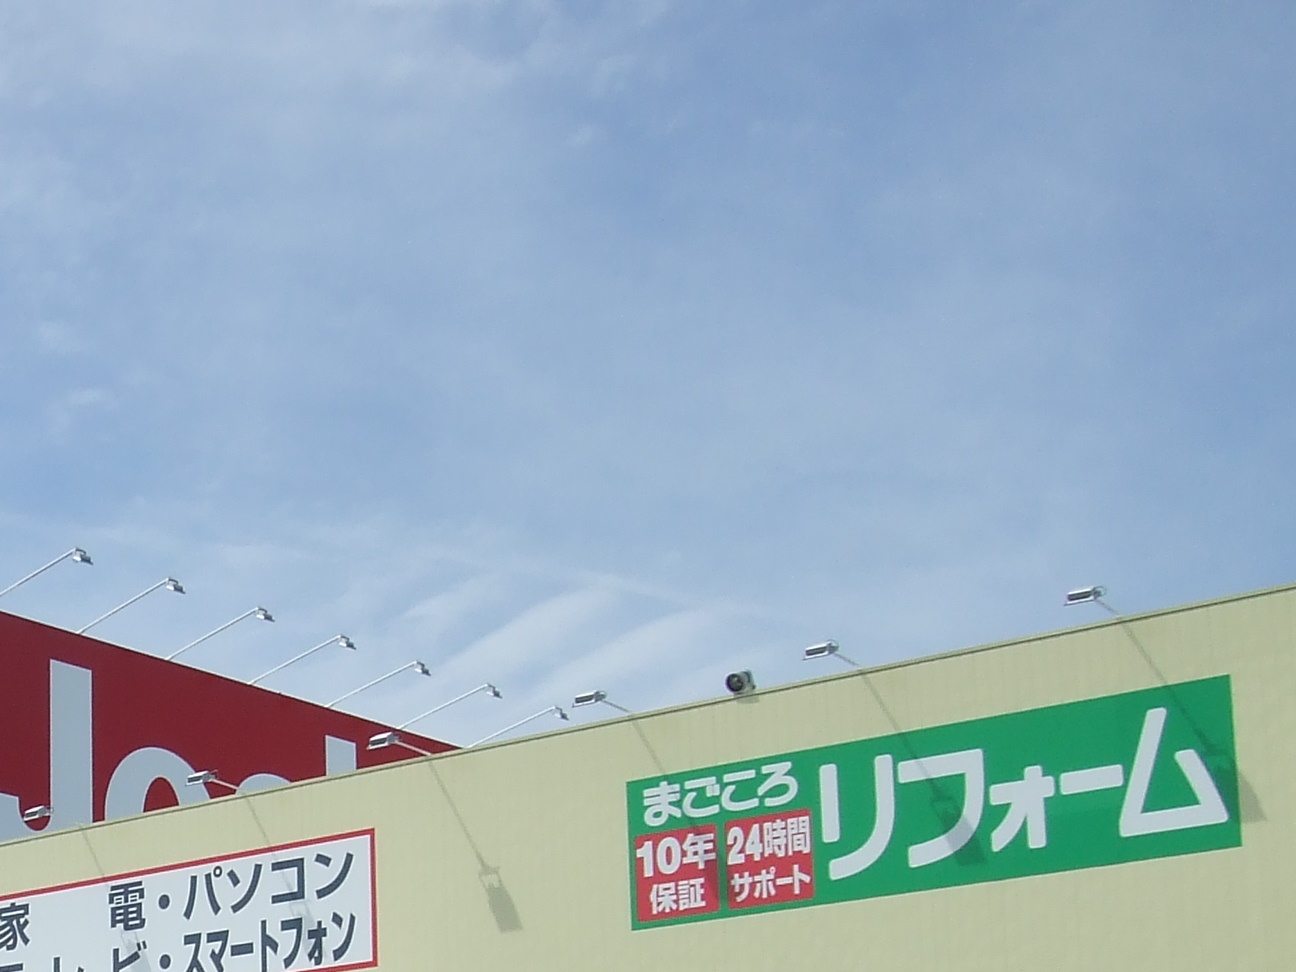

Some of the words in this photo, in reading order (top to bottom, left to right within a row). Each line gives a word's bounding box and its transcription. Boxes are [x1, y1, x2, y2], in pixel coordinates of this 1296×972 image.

[643, 761, 799, 827] まごころ
[819, 707, 1229, 880] リフォーム
[636, 833, 716, 877] 10年
[726, 815, 811, 866] 24時間
[649, 878, 706, 914] 保証
[730, 864, 811, 902] サポート
